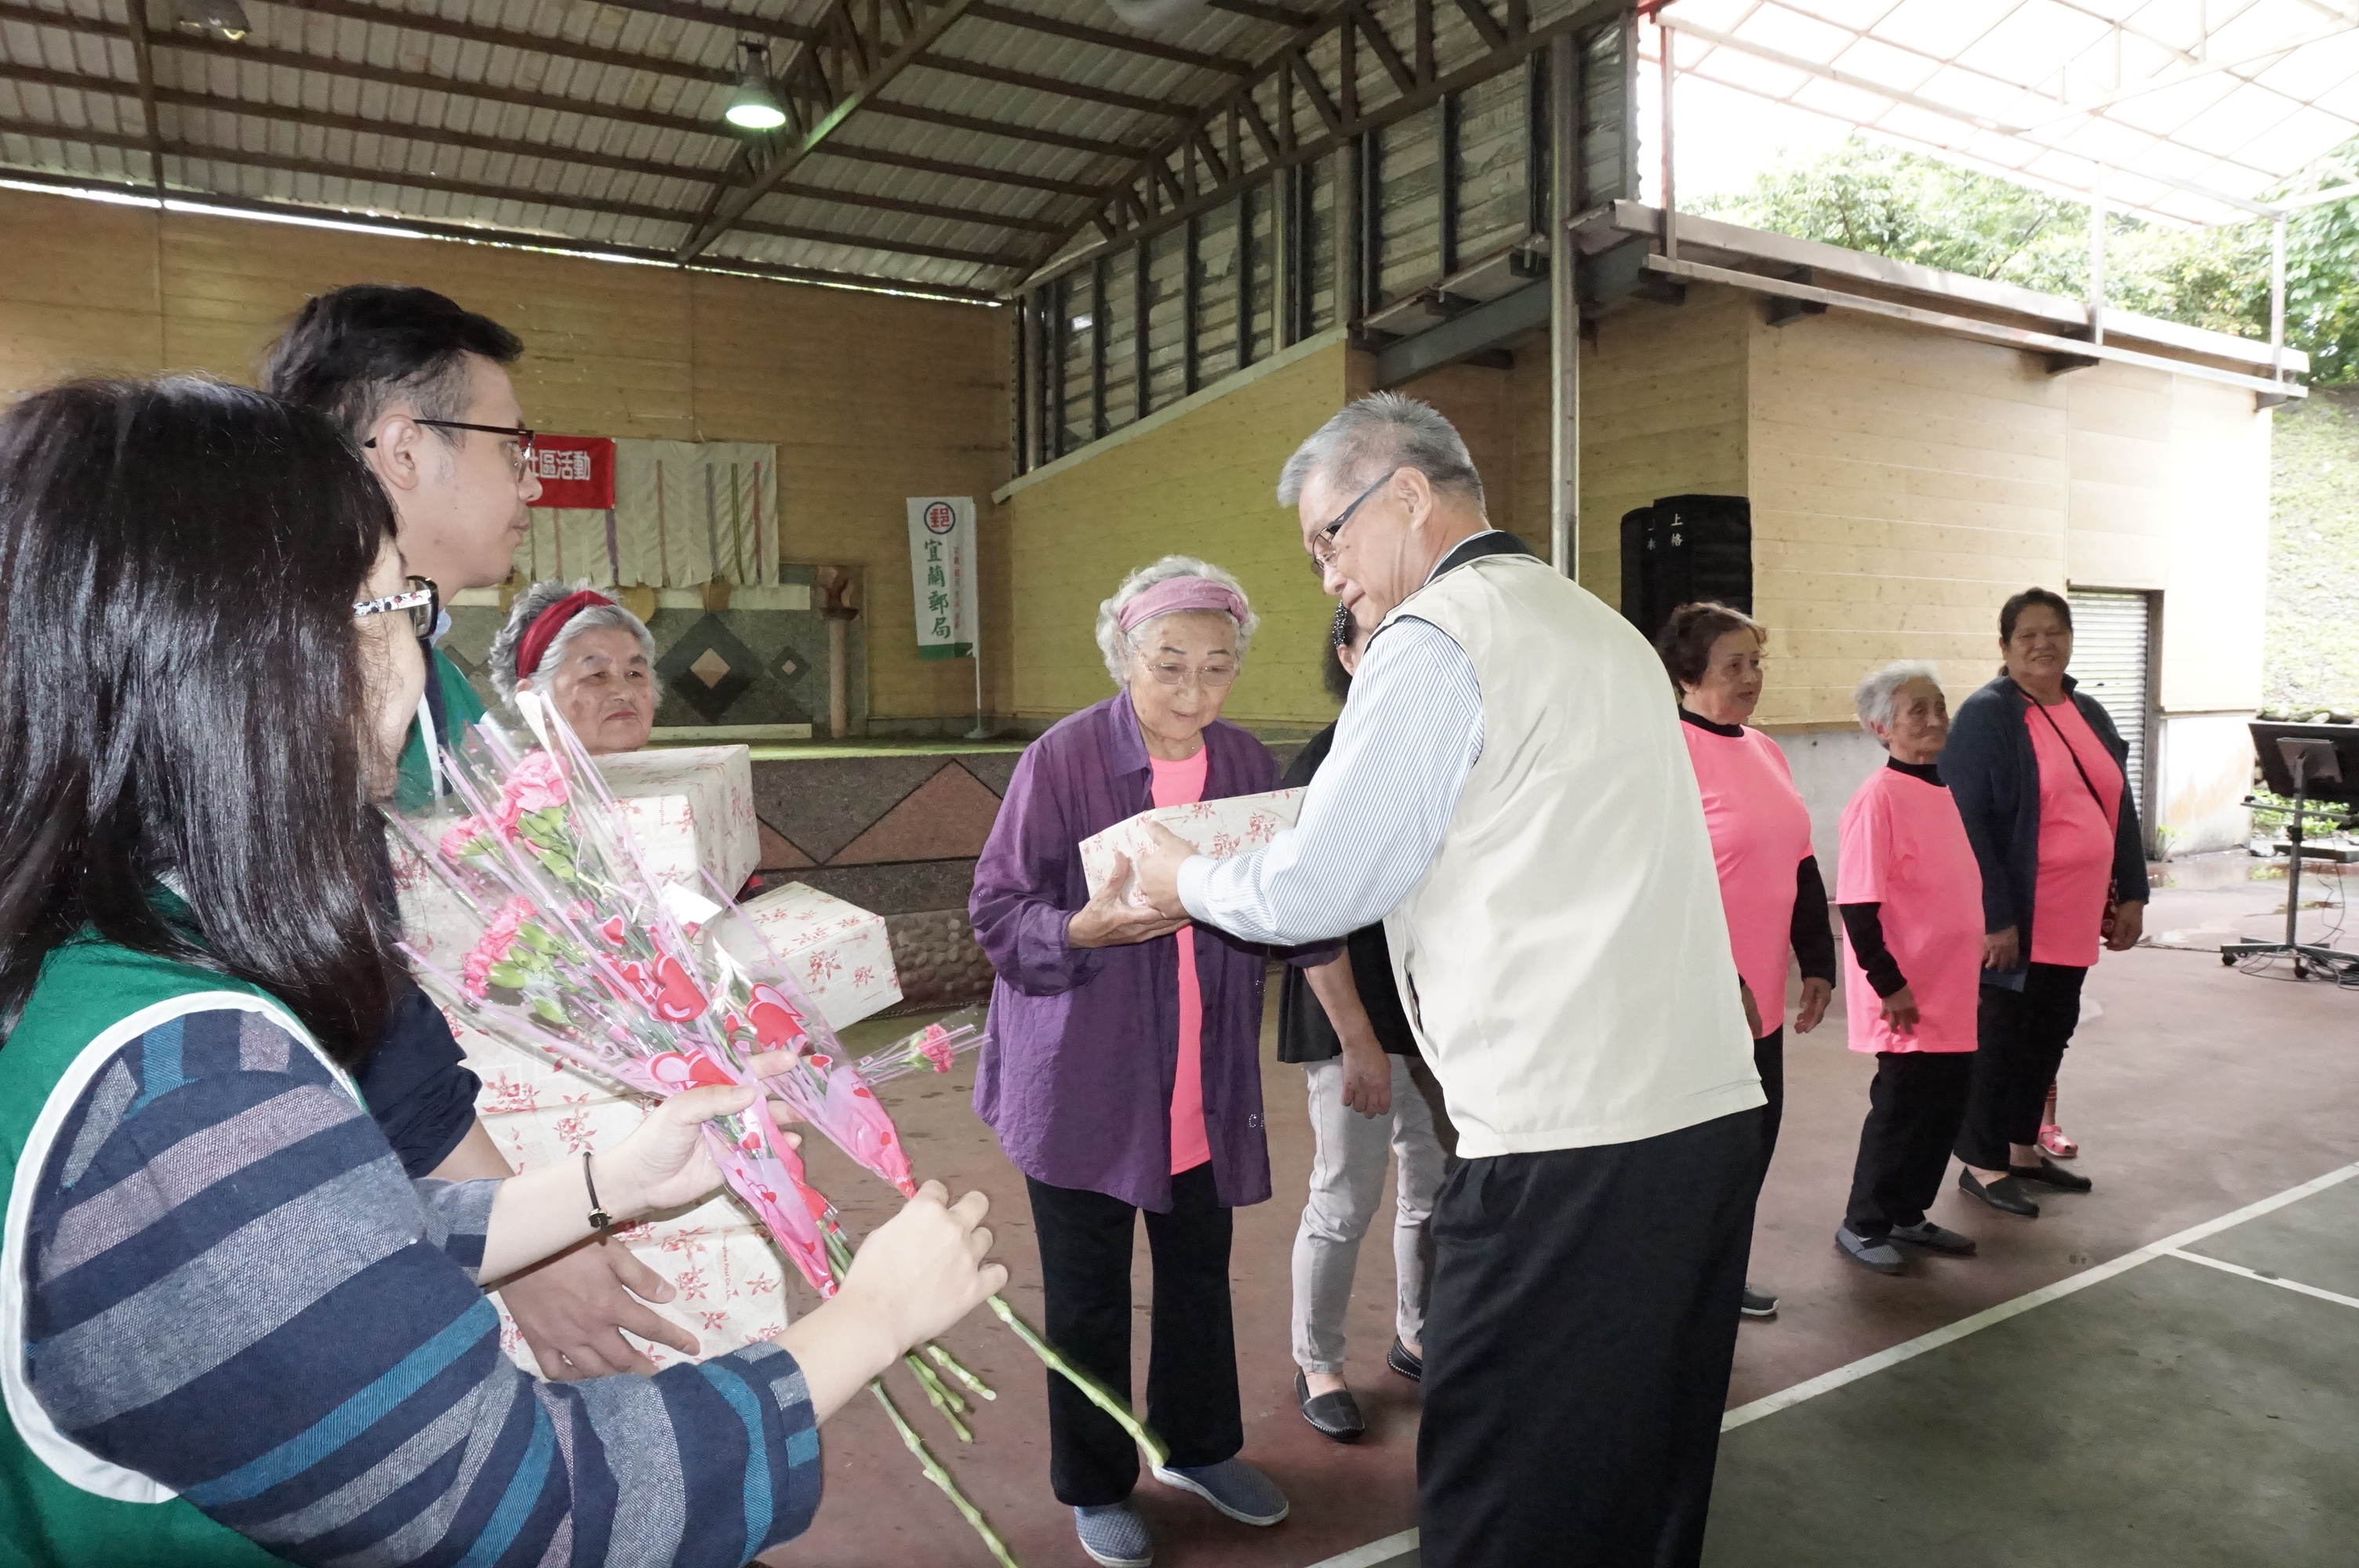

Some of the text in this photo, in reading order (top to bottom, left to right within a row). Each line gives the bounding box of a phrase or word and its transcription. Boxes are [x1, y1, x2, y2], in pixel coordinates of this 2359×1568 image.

[929, 507, 951, 528] 郵
[925, 539, 951, 639] 宜蘭郵局
